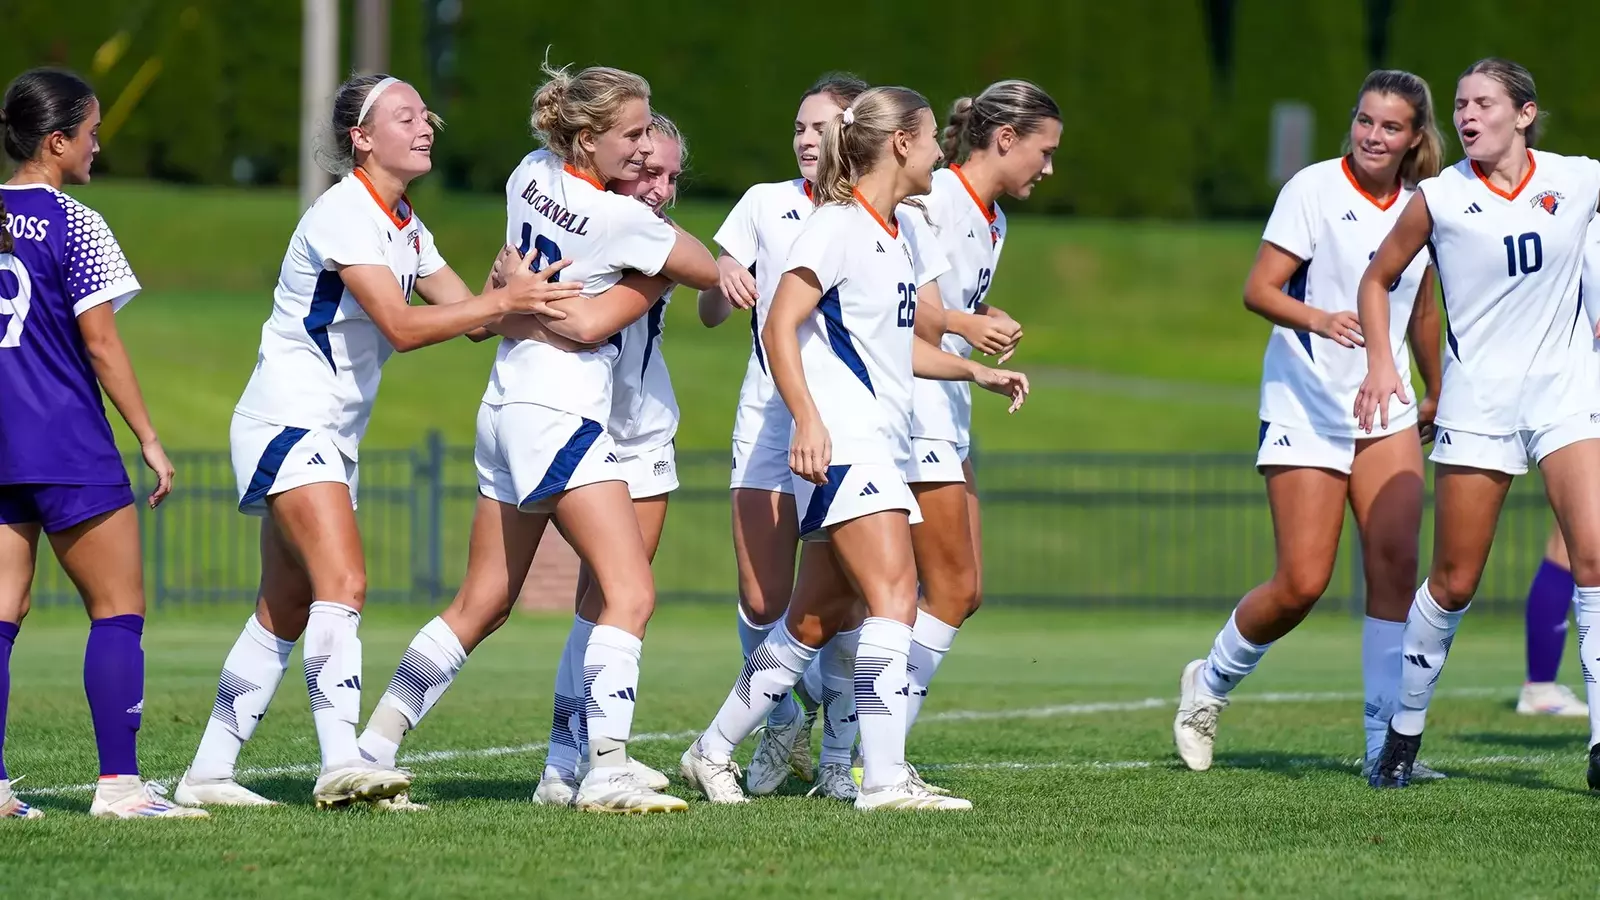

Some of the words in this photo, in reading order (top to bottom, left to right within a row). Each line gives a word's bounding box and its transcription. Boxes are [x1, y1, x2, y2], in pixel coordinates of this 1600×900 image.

[521, 179, 590, 236] BUCKNELL
[1503, 231, 1543, 277] 10
[897, 282, 916, 328] 26
